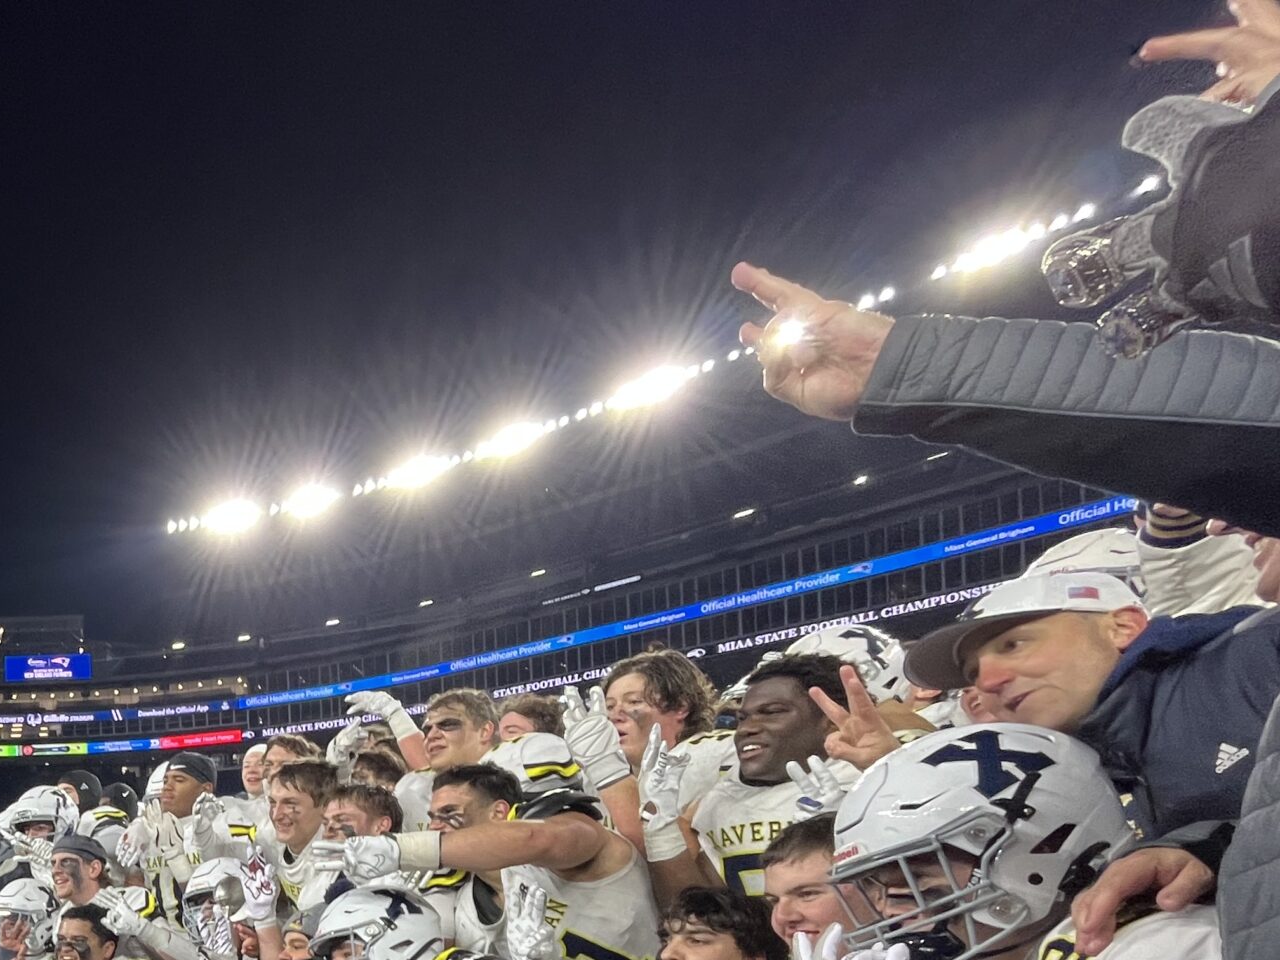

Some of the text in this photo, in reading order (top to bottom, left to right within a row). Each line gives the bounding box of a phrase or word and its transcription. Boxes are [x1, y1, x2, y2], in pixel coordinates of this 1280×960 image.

[1058, 504, 1110, 525] Official
[700, 571, 840, 614] Official Healthcare Provider
[718, 638, 753, 653] MIAA
[755, 628, 798, 646] STATE
[800, 610, 878, 636] FOOTBALL
[450, 641, 552, 672] Official Healthcare Provider
[493, 685, 526, 699] STATE
[527, 673, 582, 692] FOOTBALL
[245, 687, 334, 707] Official Healthcare Provider
[43, 714, 69, 722] Gillette
[138, 704, 209, 718] Download the Official App
[262, 717, 354, 737] MIAA STATE FOOTBA
